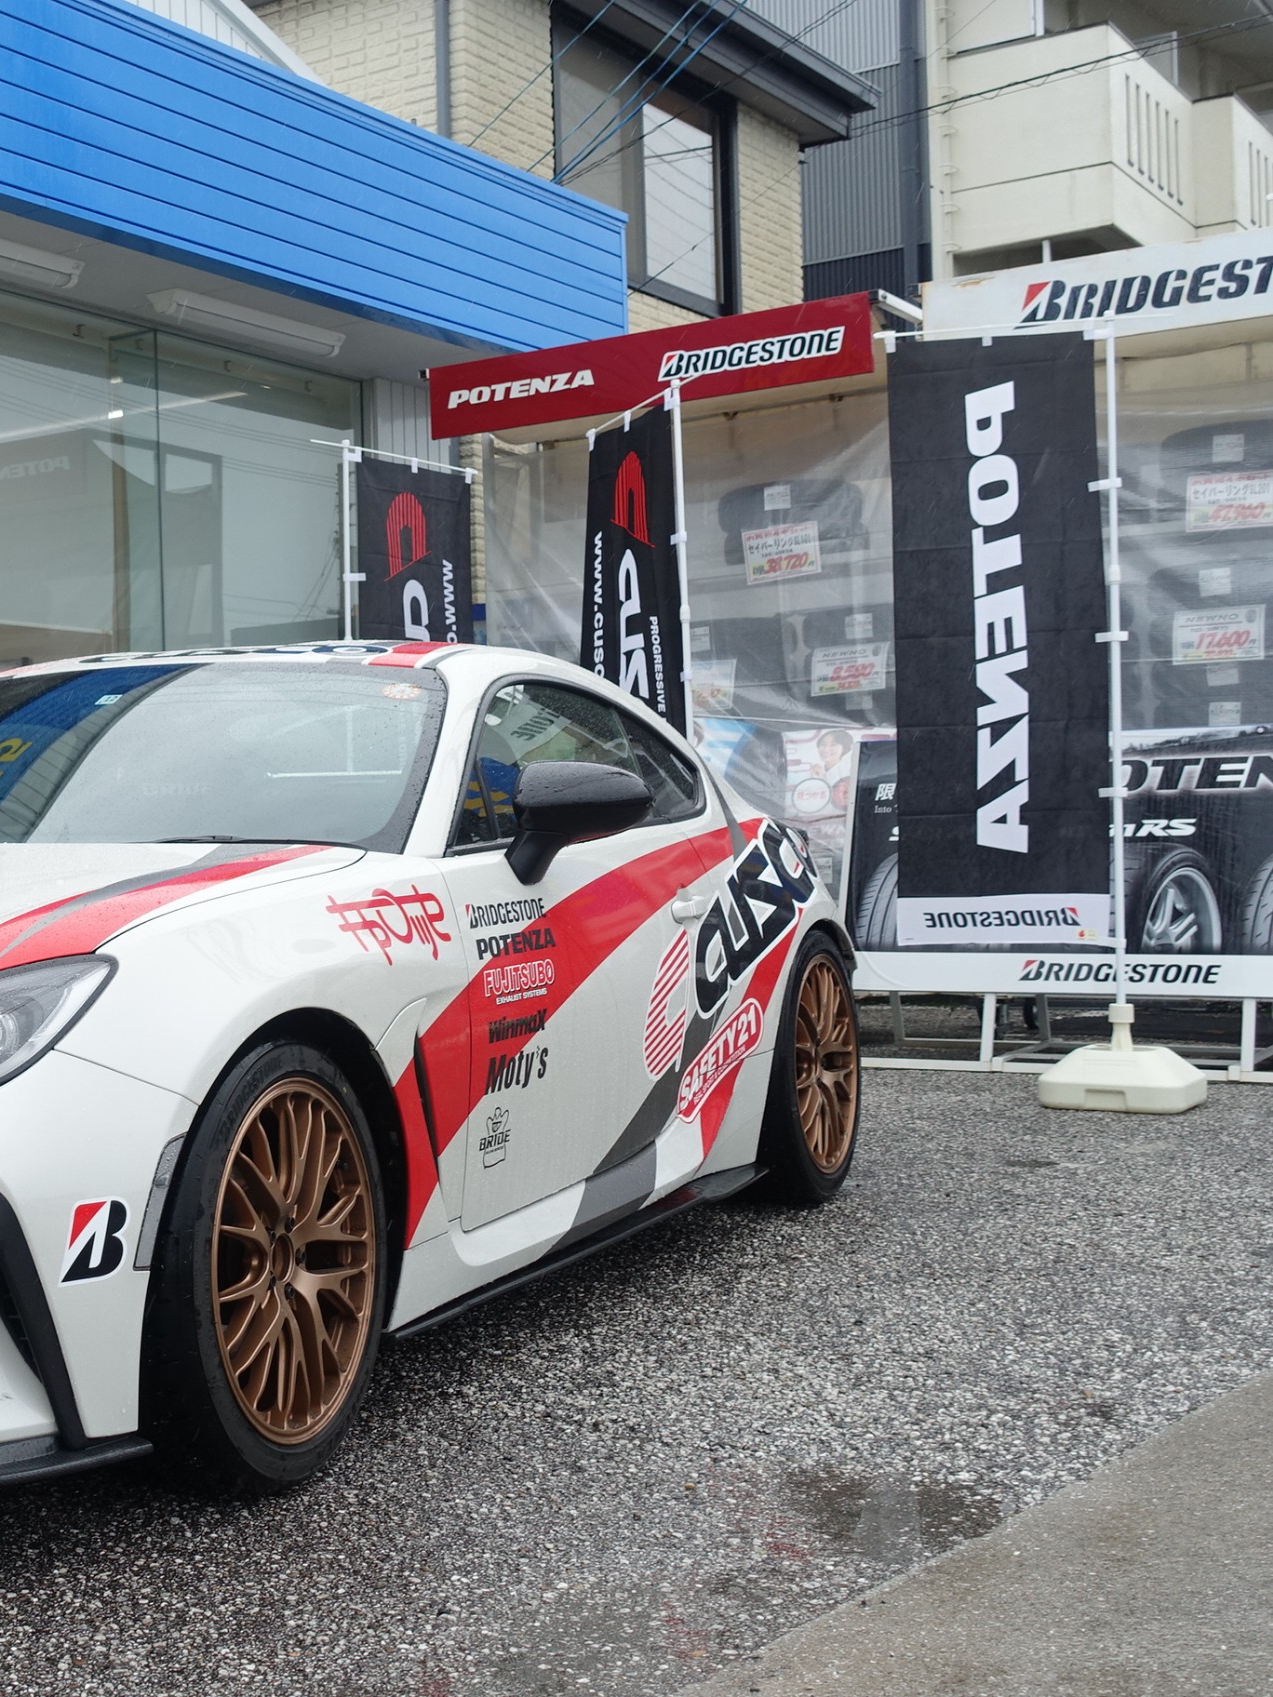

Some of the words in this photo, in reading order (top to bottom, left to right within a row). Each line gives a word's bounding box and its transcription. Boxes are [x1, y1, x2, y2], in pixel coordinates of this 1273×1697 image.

[1014, 256, 1273, 329] BRIDGEST
[447, 369, 594, 409] POTENZA
[659, 327, 844, 381] BRIDGESTONE
[649, 616, 667, 713] PROGRESSIVE
[465, 897, 547, 930] BRIDGESTONE
[476, 927, 556, 960] POTENZA
[484, 958, 555, 998] FUJITSUBO
[484, 1046, 549, 1096] Moty's
[479, 1128, 511, 1152] BRIDE
